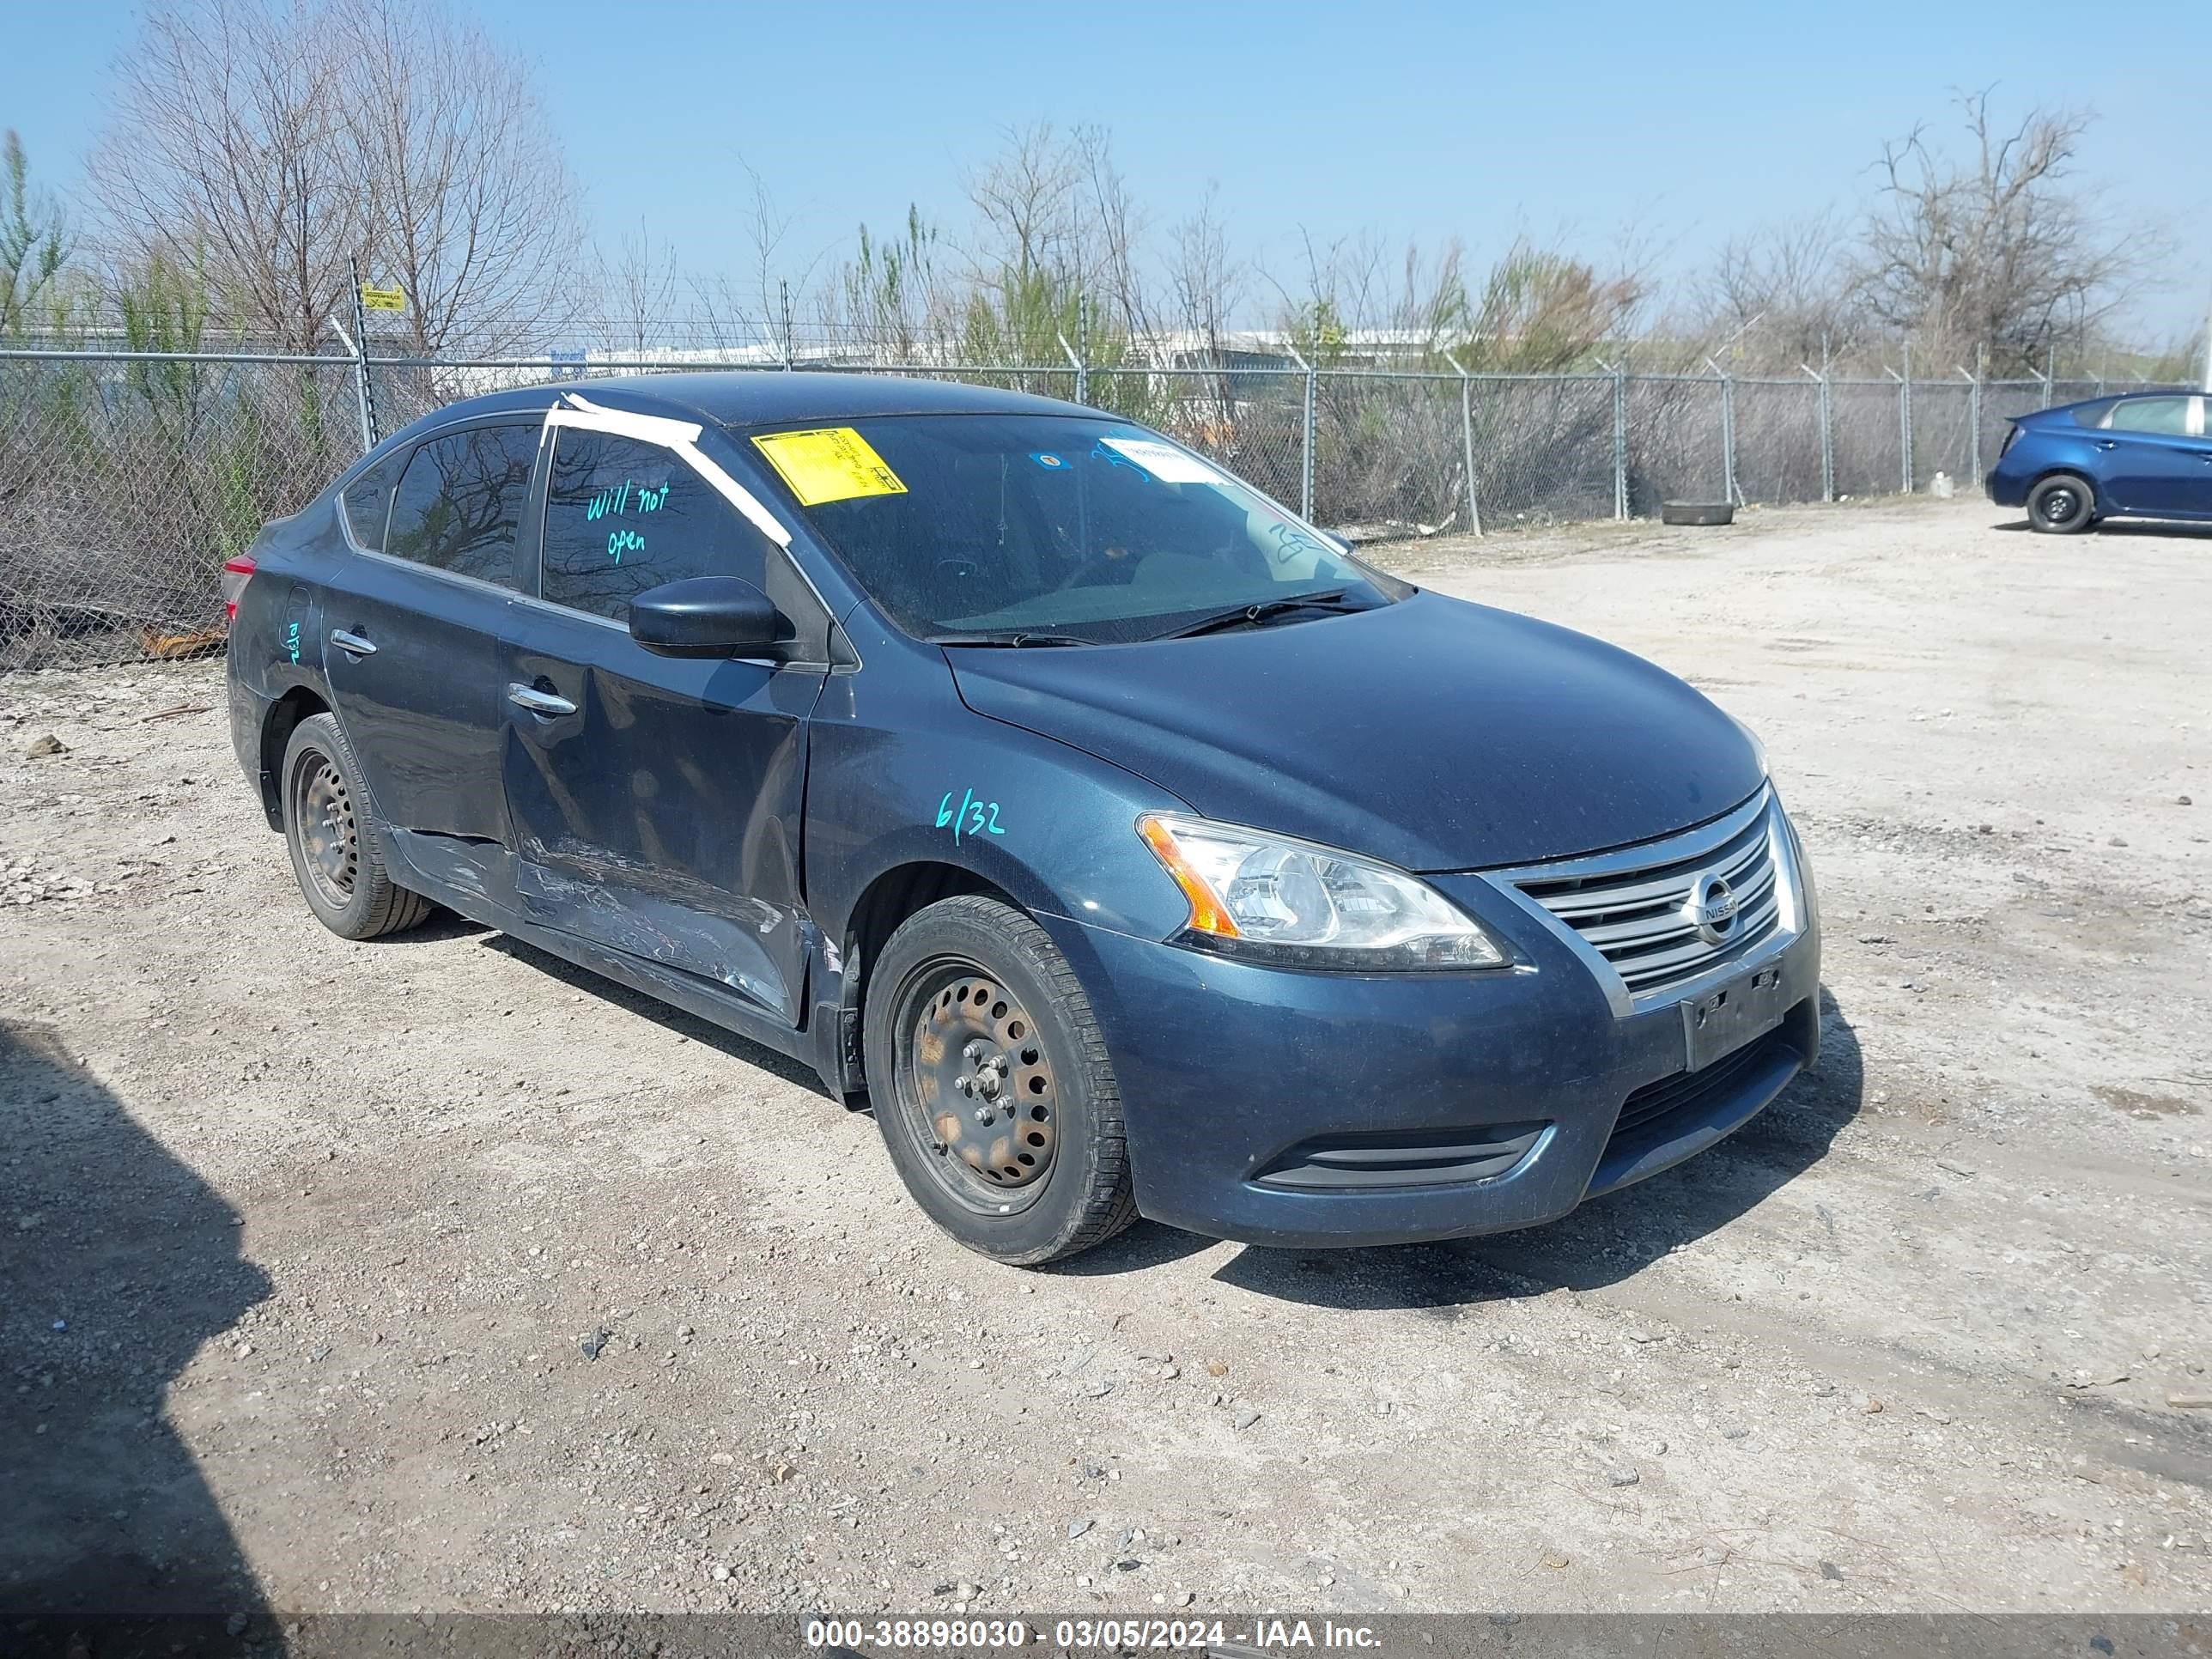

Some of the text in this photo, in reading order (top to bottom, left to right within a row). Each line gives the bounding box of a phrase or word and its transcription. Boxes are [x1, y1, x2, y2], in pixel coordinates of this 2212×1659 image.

[638, 481, 669, 514] not
[608, 529, 645, 564] open
[935, 787, 1006, 847] 6/32
[1705, 900, 1738, 921] NISSAN
